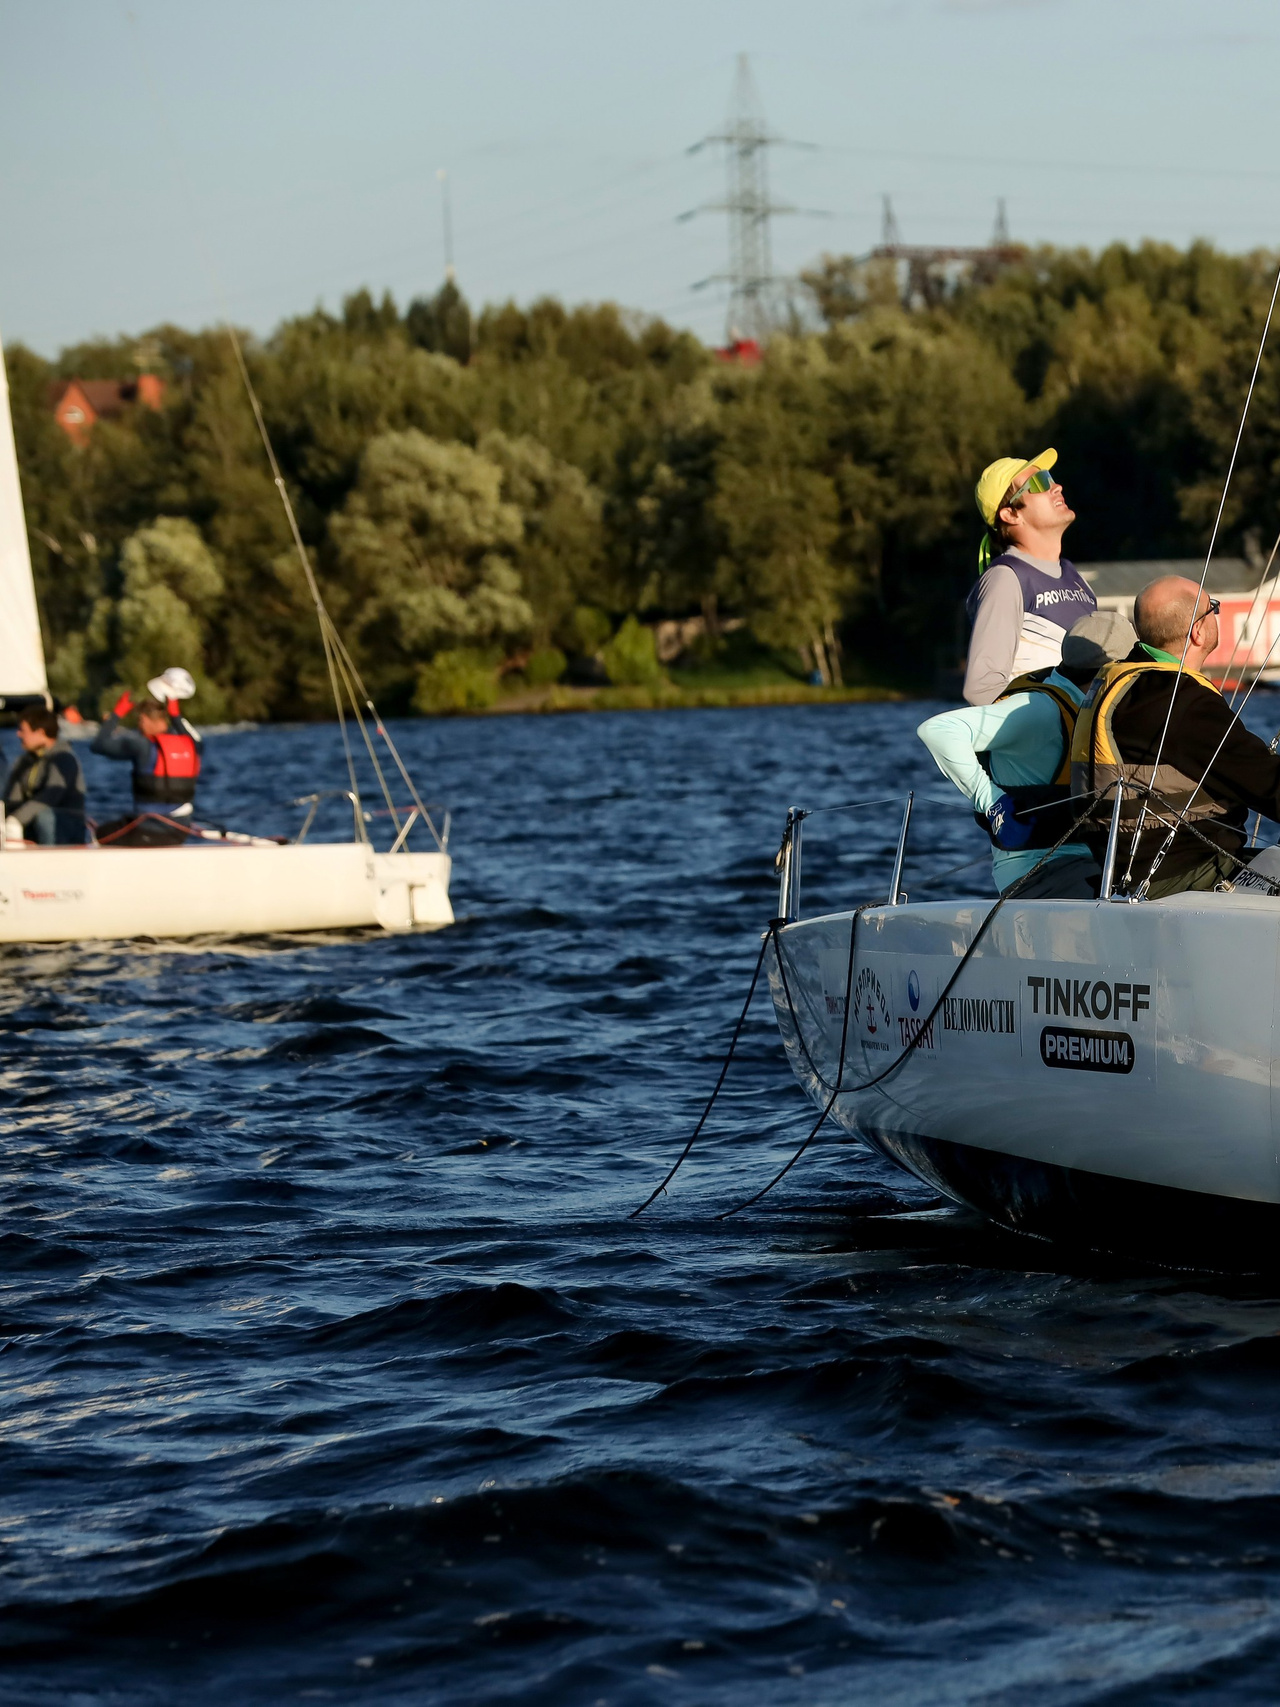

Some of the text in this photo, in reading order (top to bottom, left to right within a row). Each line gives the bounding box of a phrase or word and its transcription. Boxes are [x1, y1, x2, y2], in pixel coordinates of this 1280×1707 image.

[1027, 976, 1150, 1022] TINKOFF
[897, 1017, 935, 1049] TASSAY
[942, 998, 1015, 1035] ВЕДОМОСТИ
[1045, 1034, 1129, 1066] PREMIUM
